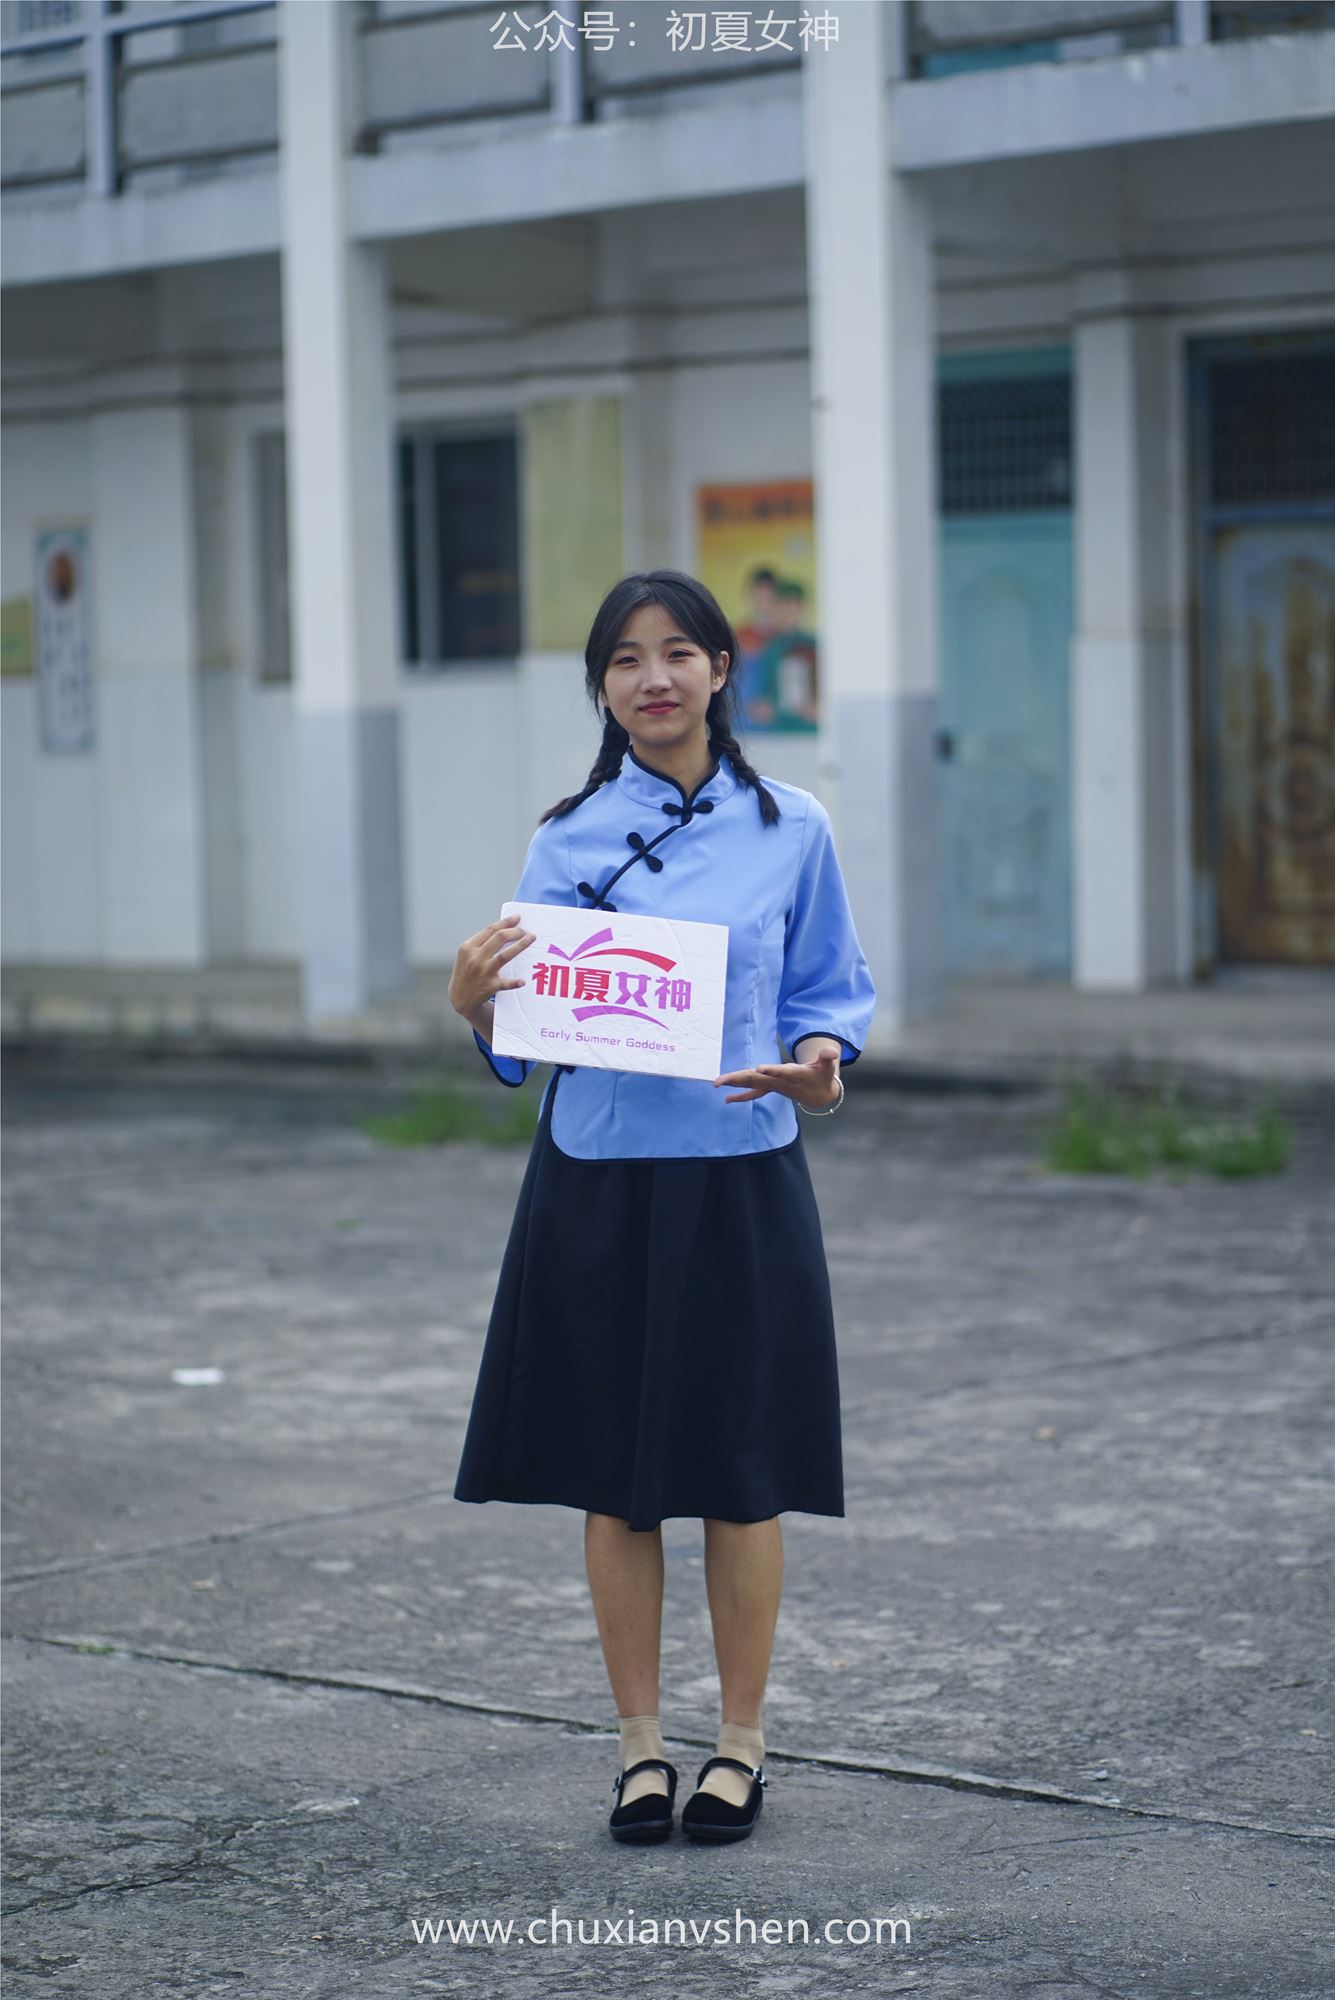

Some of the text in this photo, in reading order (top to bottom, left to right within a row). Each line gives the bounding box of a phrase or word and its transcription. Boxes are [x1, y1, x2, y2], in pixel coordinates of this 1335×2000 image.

[532, 962, 692, 1012] 初夏女神
[540, 1027, 676, 1052] Early Summer Goddess
